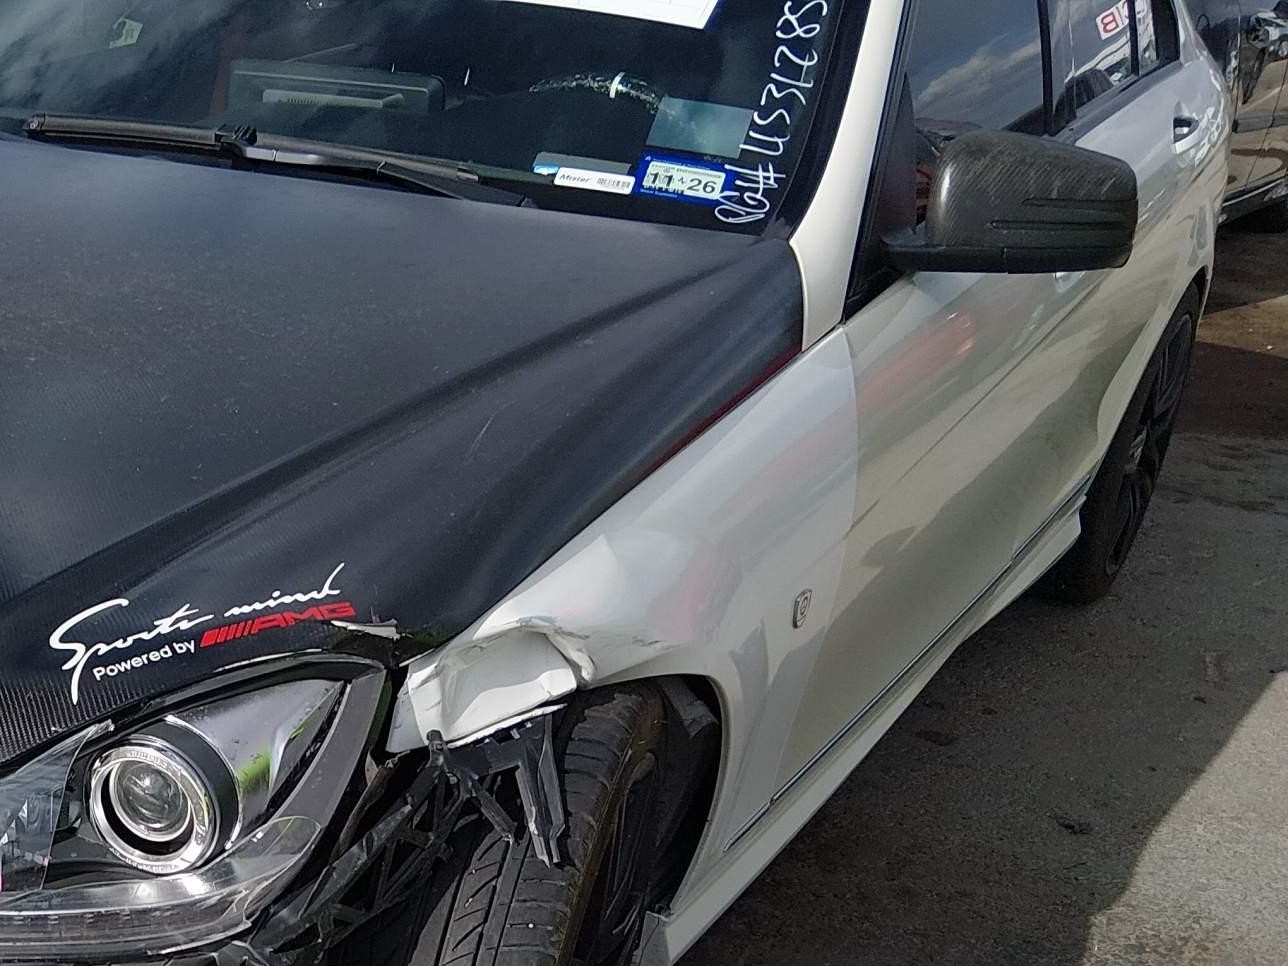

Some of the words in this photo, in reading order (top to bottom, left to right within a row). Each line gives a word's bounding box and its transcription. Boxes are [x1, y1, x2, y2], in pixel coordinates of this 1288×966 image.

[649, 172, 674, 186] 11
[687, 178, 718, 194] 26
[92, 647, 174, 681] Powered
[174, 640, 196, 660] by
